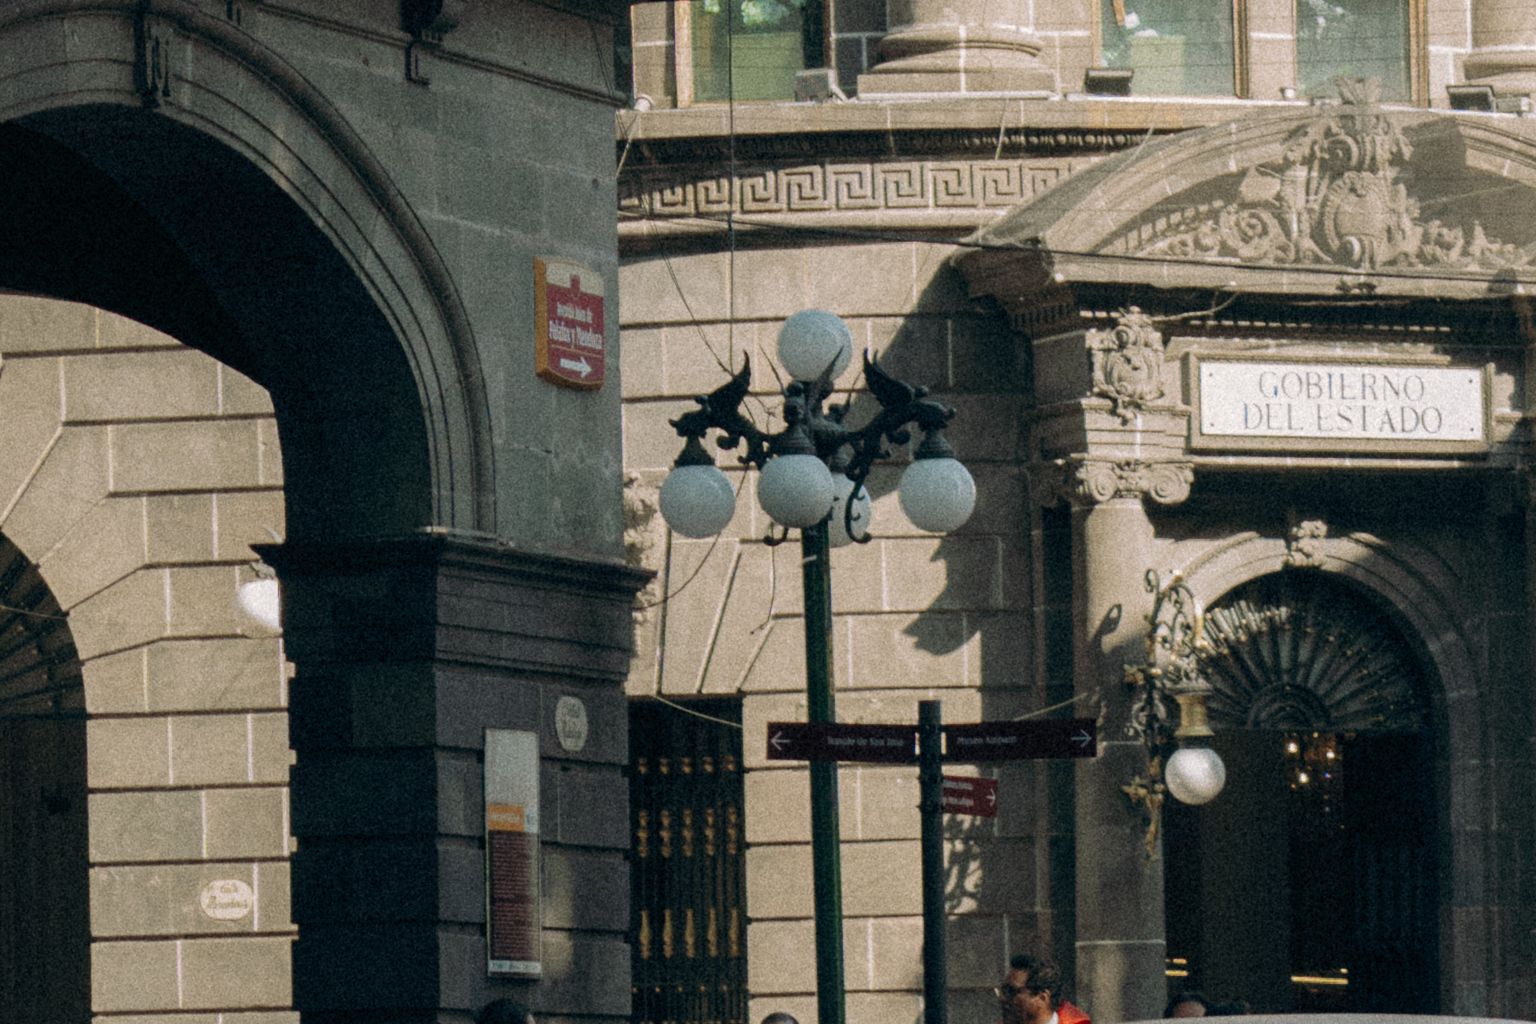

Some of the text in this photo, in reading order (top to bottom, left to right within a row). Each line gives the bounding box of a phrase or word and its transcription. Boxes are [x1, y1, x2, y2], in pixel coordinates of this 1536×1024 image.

[1257, 370, 1426, 401] GOBIERNO
[1243, 402, 1443, 434] DEL ESTADO
